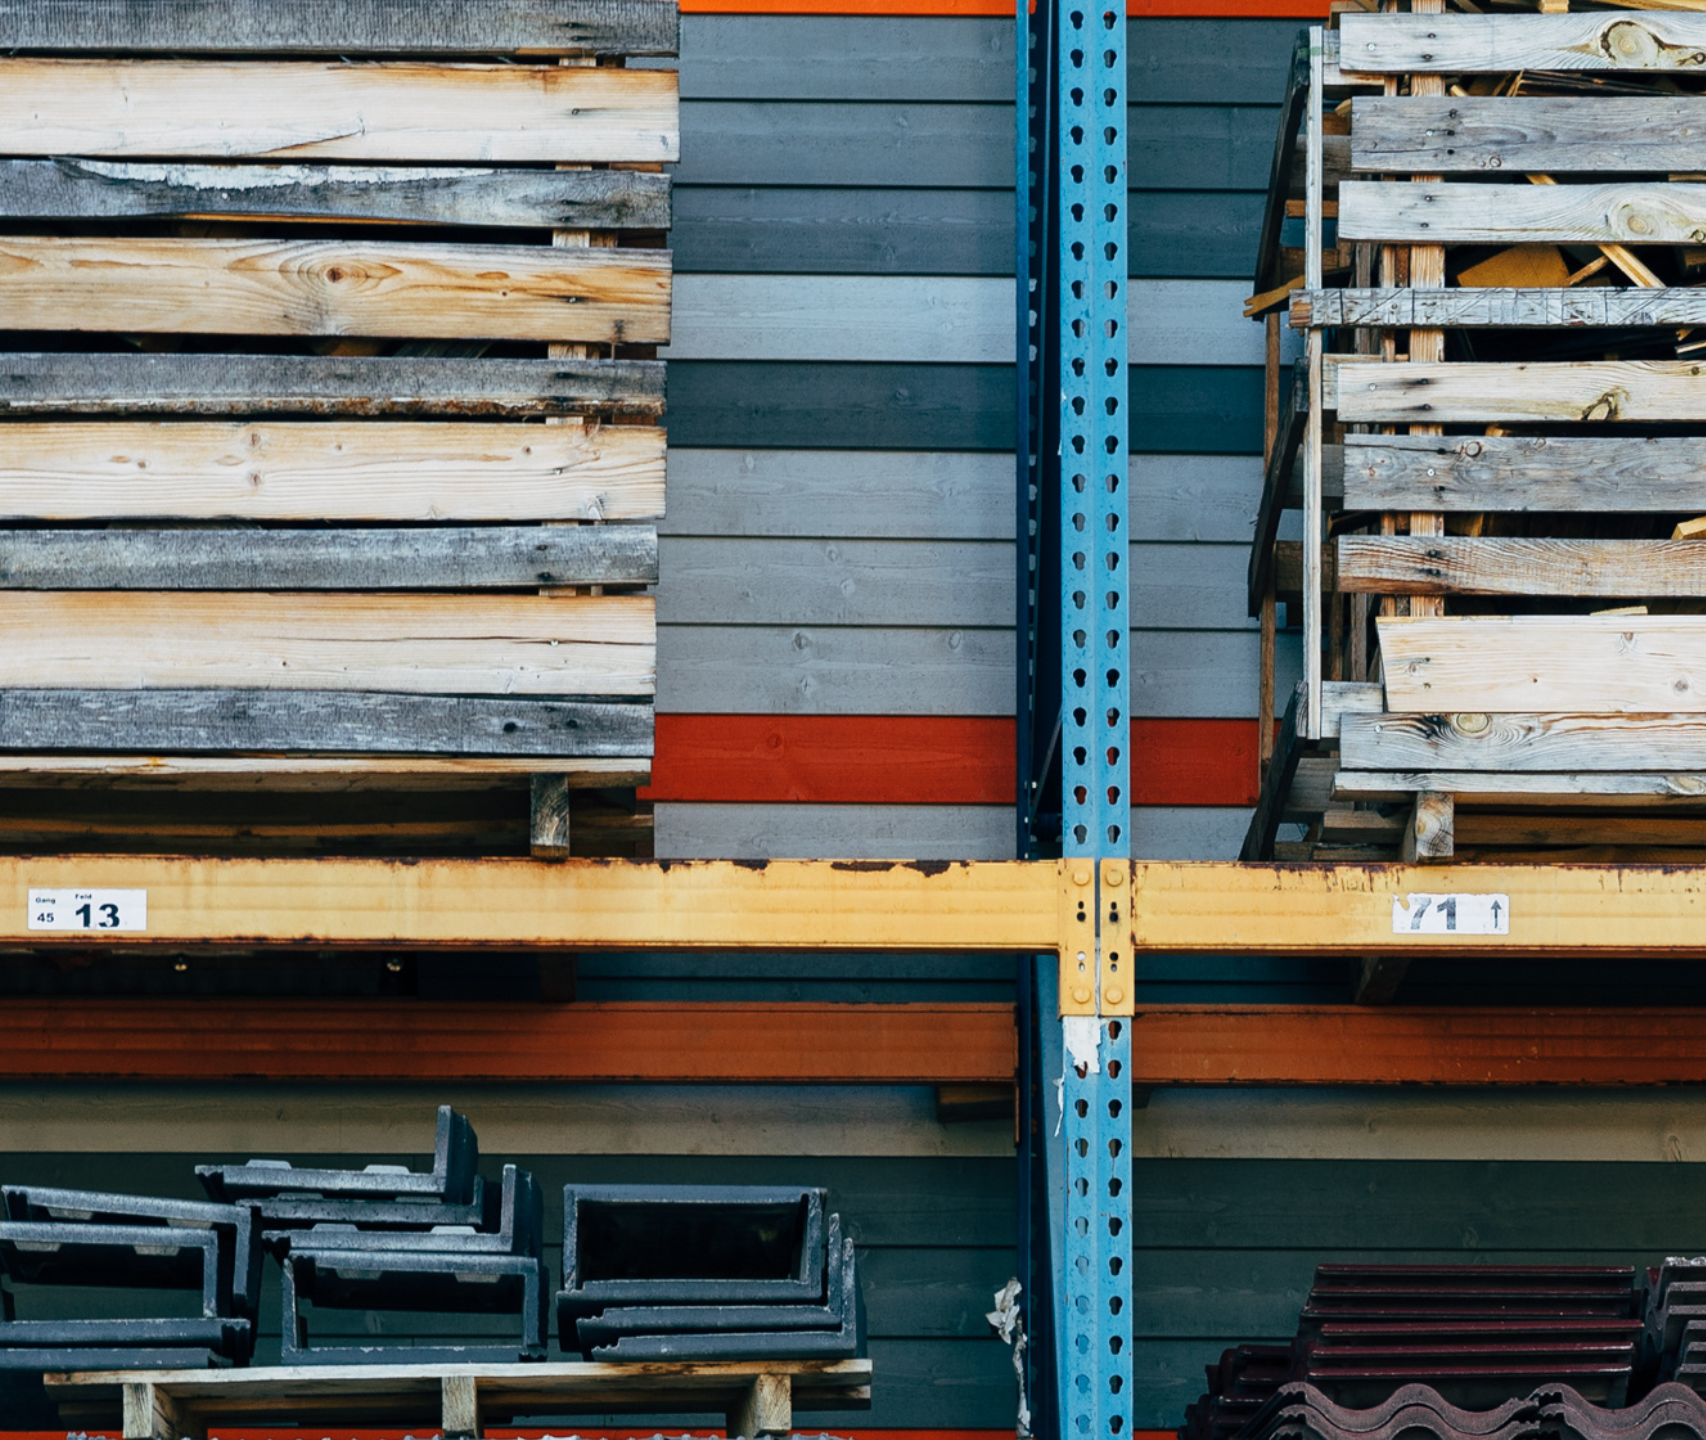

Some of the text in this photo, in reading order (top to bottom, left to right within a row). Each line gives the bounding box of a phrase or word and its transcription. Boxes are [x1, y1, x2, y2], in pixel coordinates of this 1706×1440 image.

[37, 903, 120, 928] 45 13
[1410, 897, 1457, 931] 71
